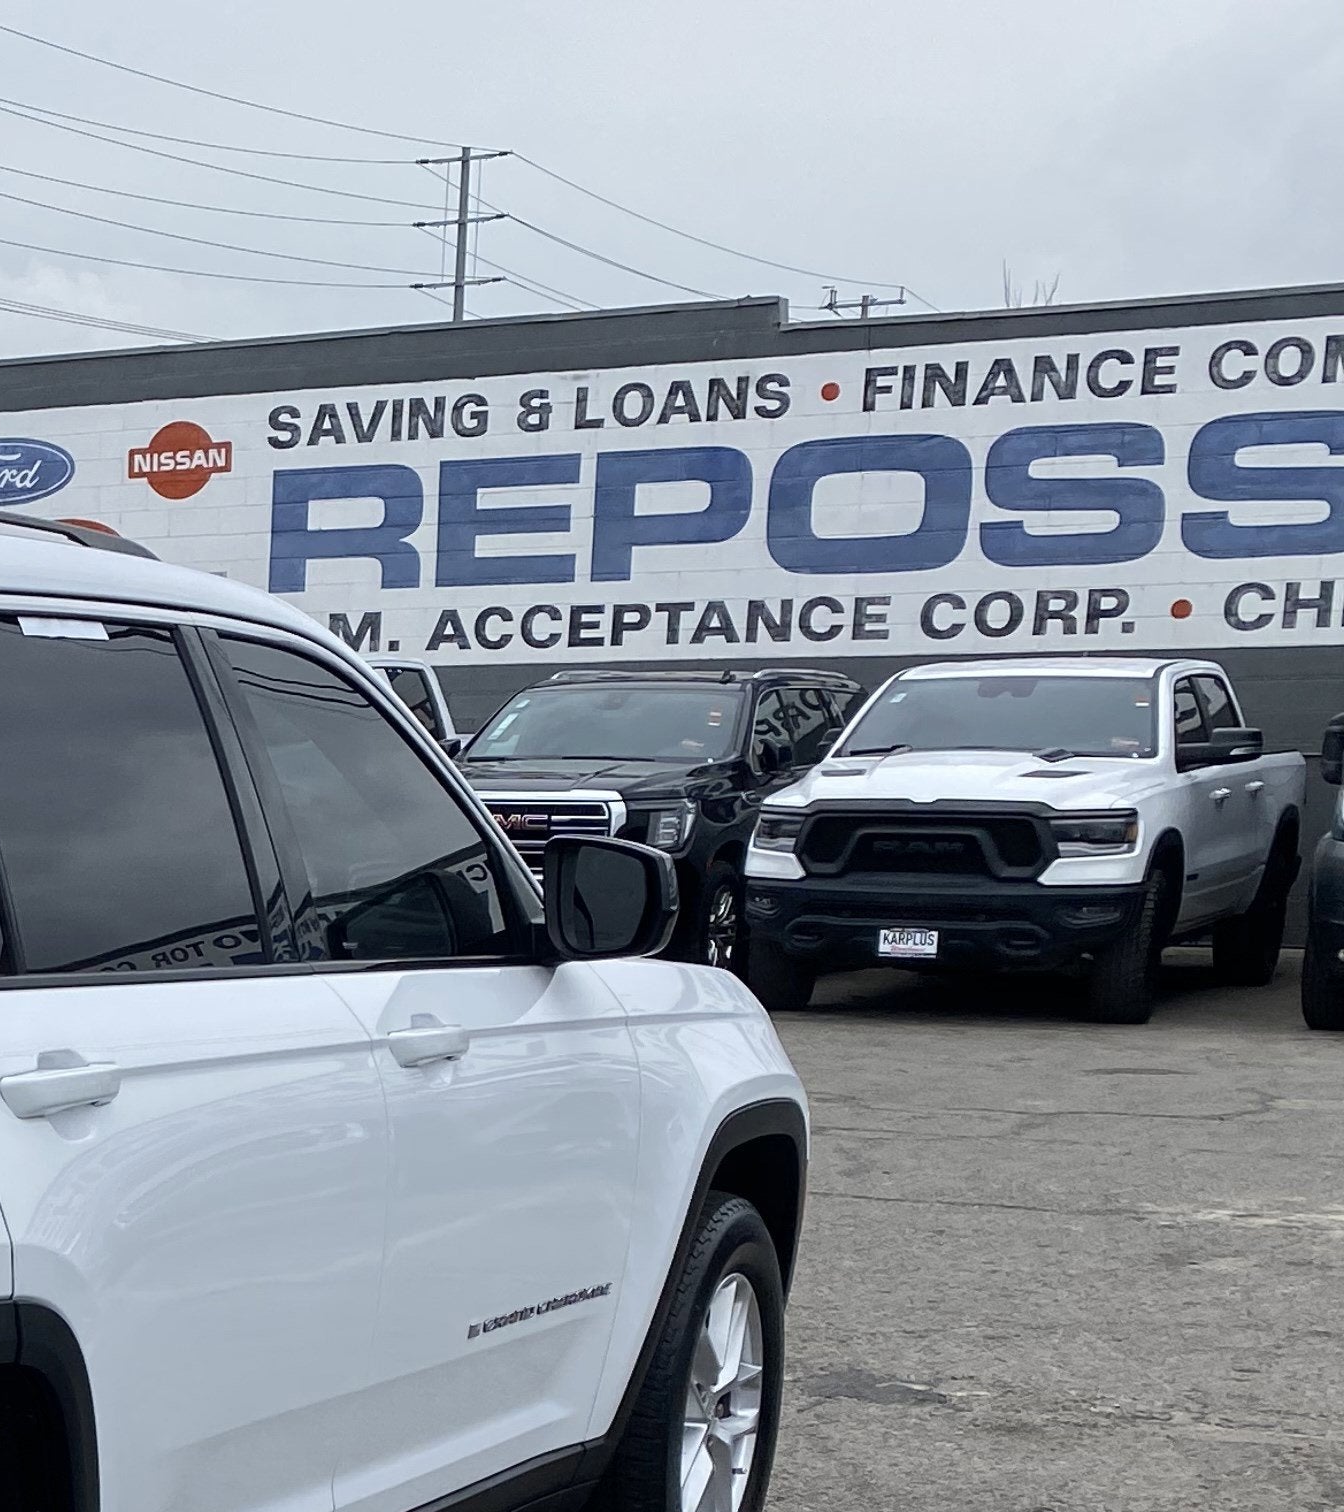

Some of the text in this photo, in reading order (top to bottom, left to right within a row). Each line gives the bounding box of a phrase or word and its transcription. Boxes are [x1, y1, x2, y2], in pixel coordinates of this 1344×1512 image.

[266, 393, 489, 450] SAVING
[516, 389, 554, 432] &
[573, 373, 792, 431] LOANS
[862, 345, 1181, 412] FINANCE
[132, 446, 227, 474] NISSAN
[268, 409, 1344, 593] REPOSS
[424, 595, 892, 651] ACCEPTANCE
[918, 588, 1135, 640] CORP.
[1223, 578, 1344, 631] CH
[492, 814, 549, 830] MC
[883, 932, 935, 946] KARPLUS
